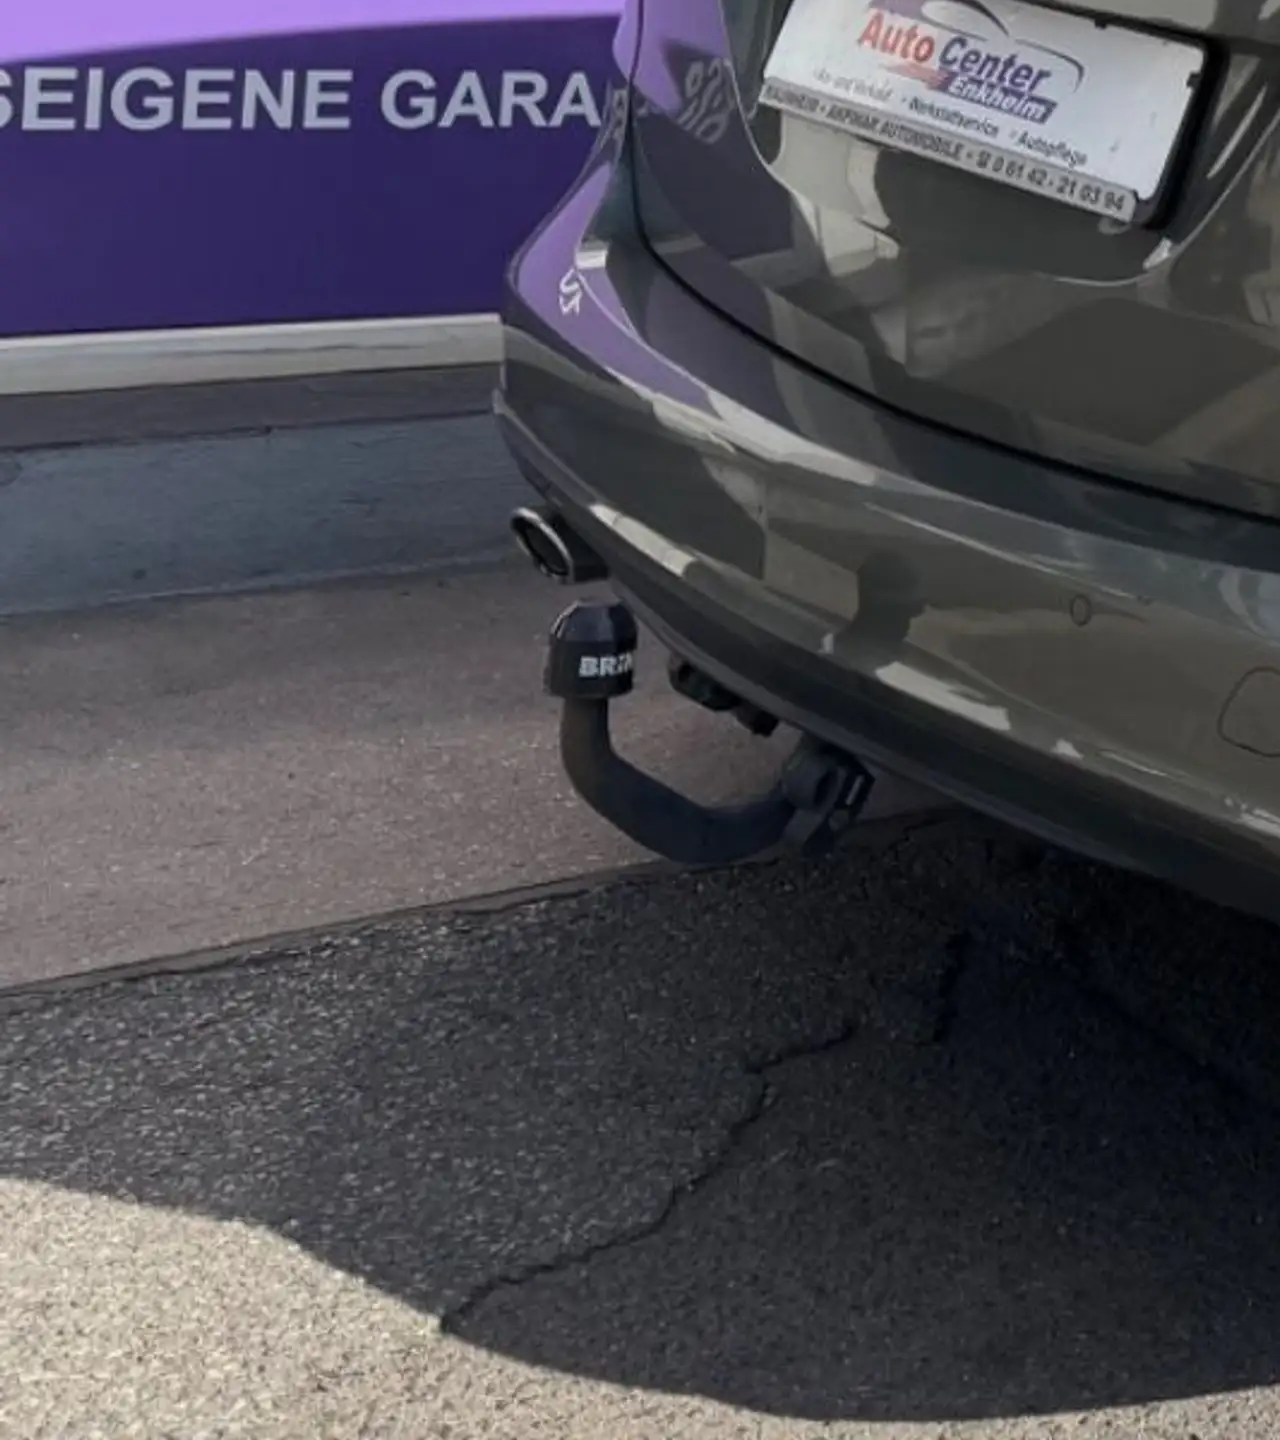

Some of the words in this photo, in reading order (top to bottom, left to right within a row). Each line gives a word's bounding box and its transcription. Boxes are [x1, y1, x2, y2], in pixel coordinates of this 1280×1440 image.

[857, 10, 935, 63] Auto
[939, 35, 1050, 93] Center
[0, 66, 353, 132] EIGENE
